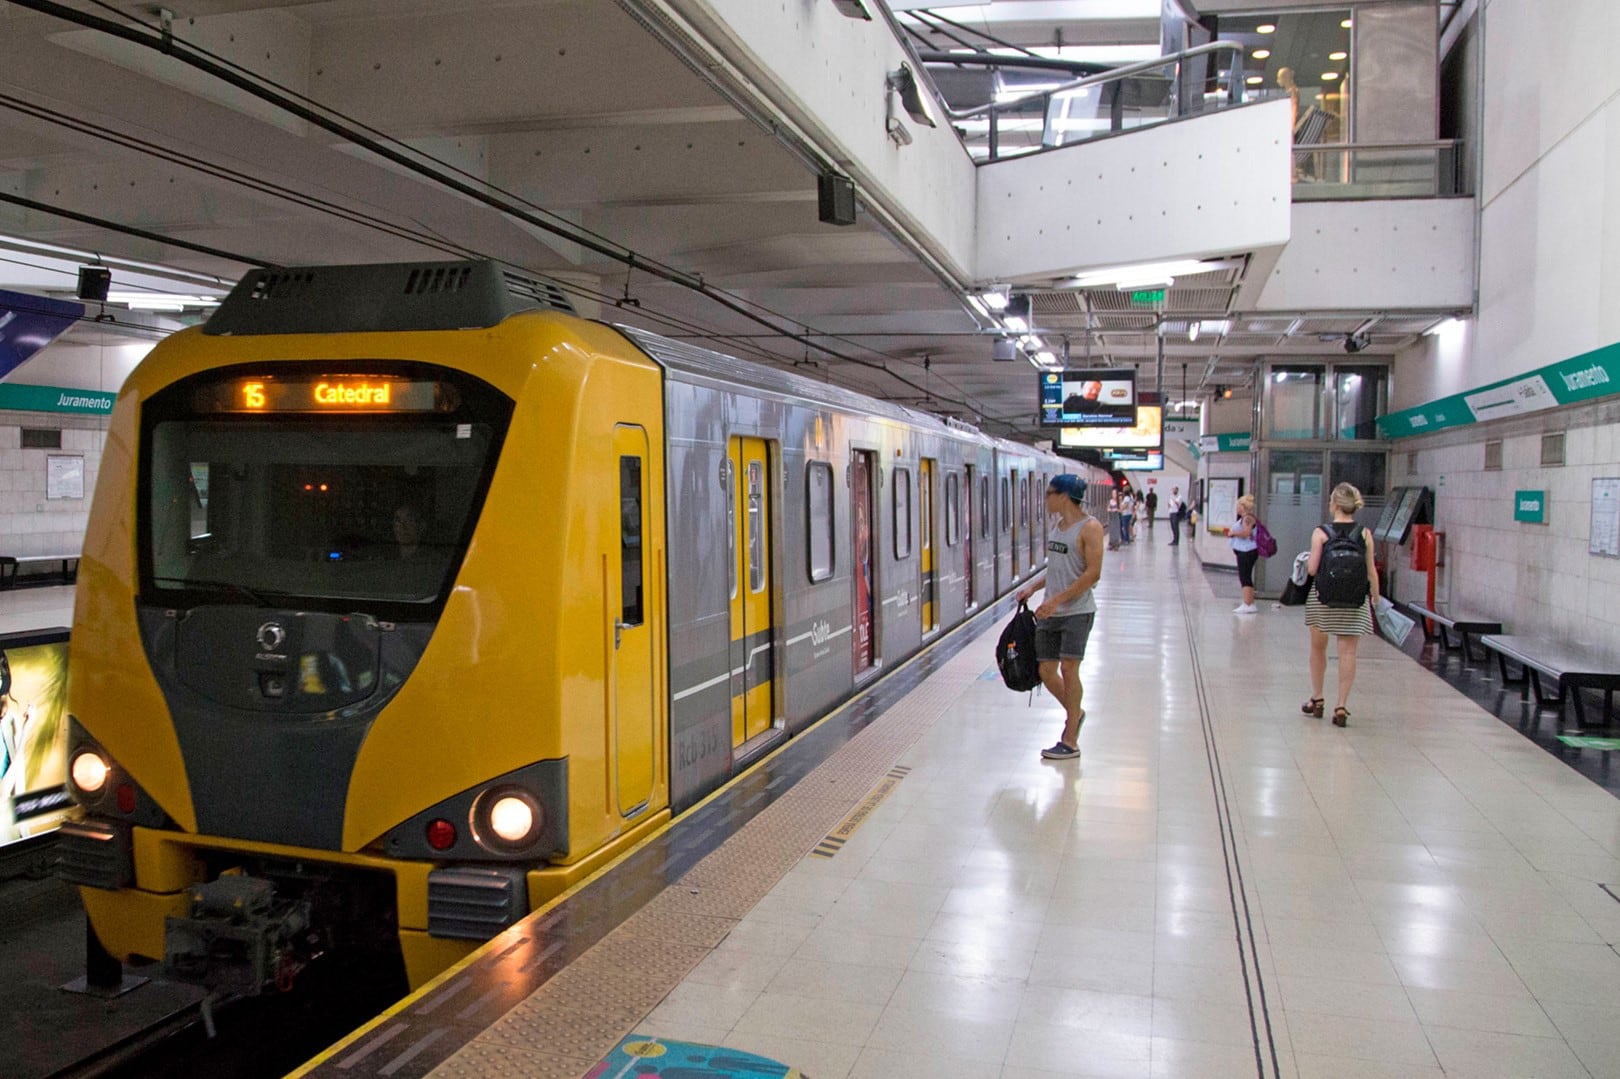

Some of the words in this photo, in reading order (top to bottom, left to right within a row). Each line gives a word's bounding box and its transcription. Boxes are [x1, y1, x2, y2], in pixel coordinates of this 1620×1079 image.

[1560, 363, 1610, 392] Juramento
[57, 393, 112, 410] Juramento
[242, 382, 265, 407] 15
[315, 383, 390, 404] Catedral
